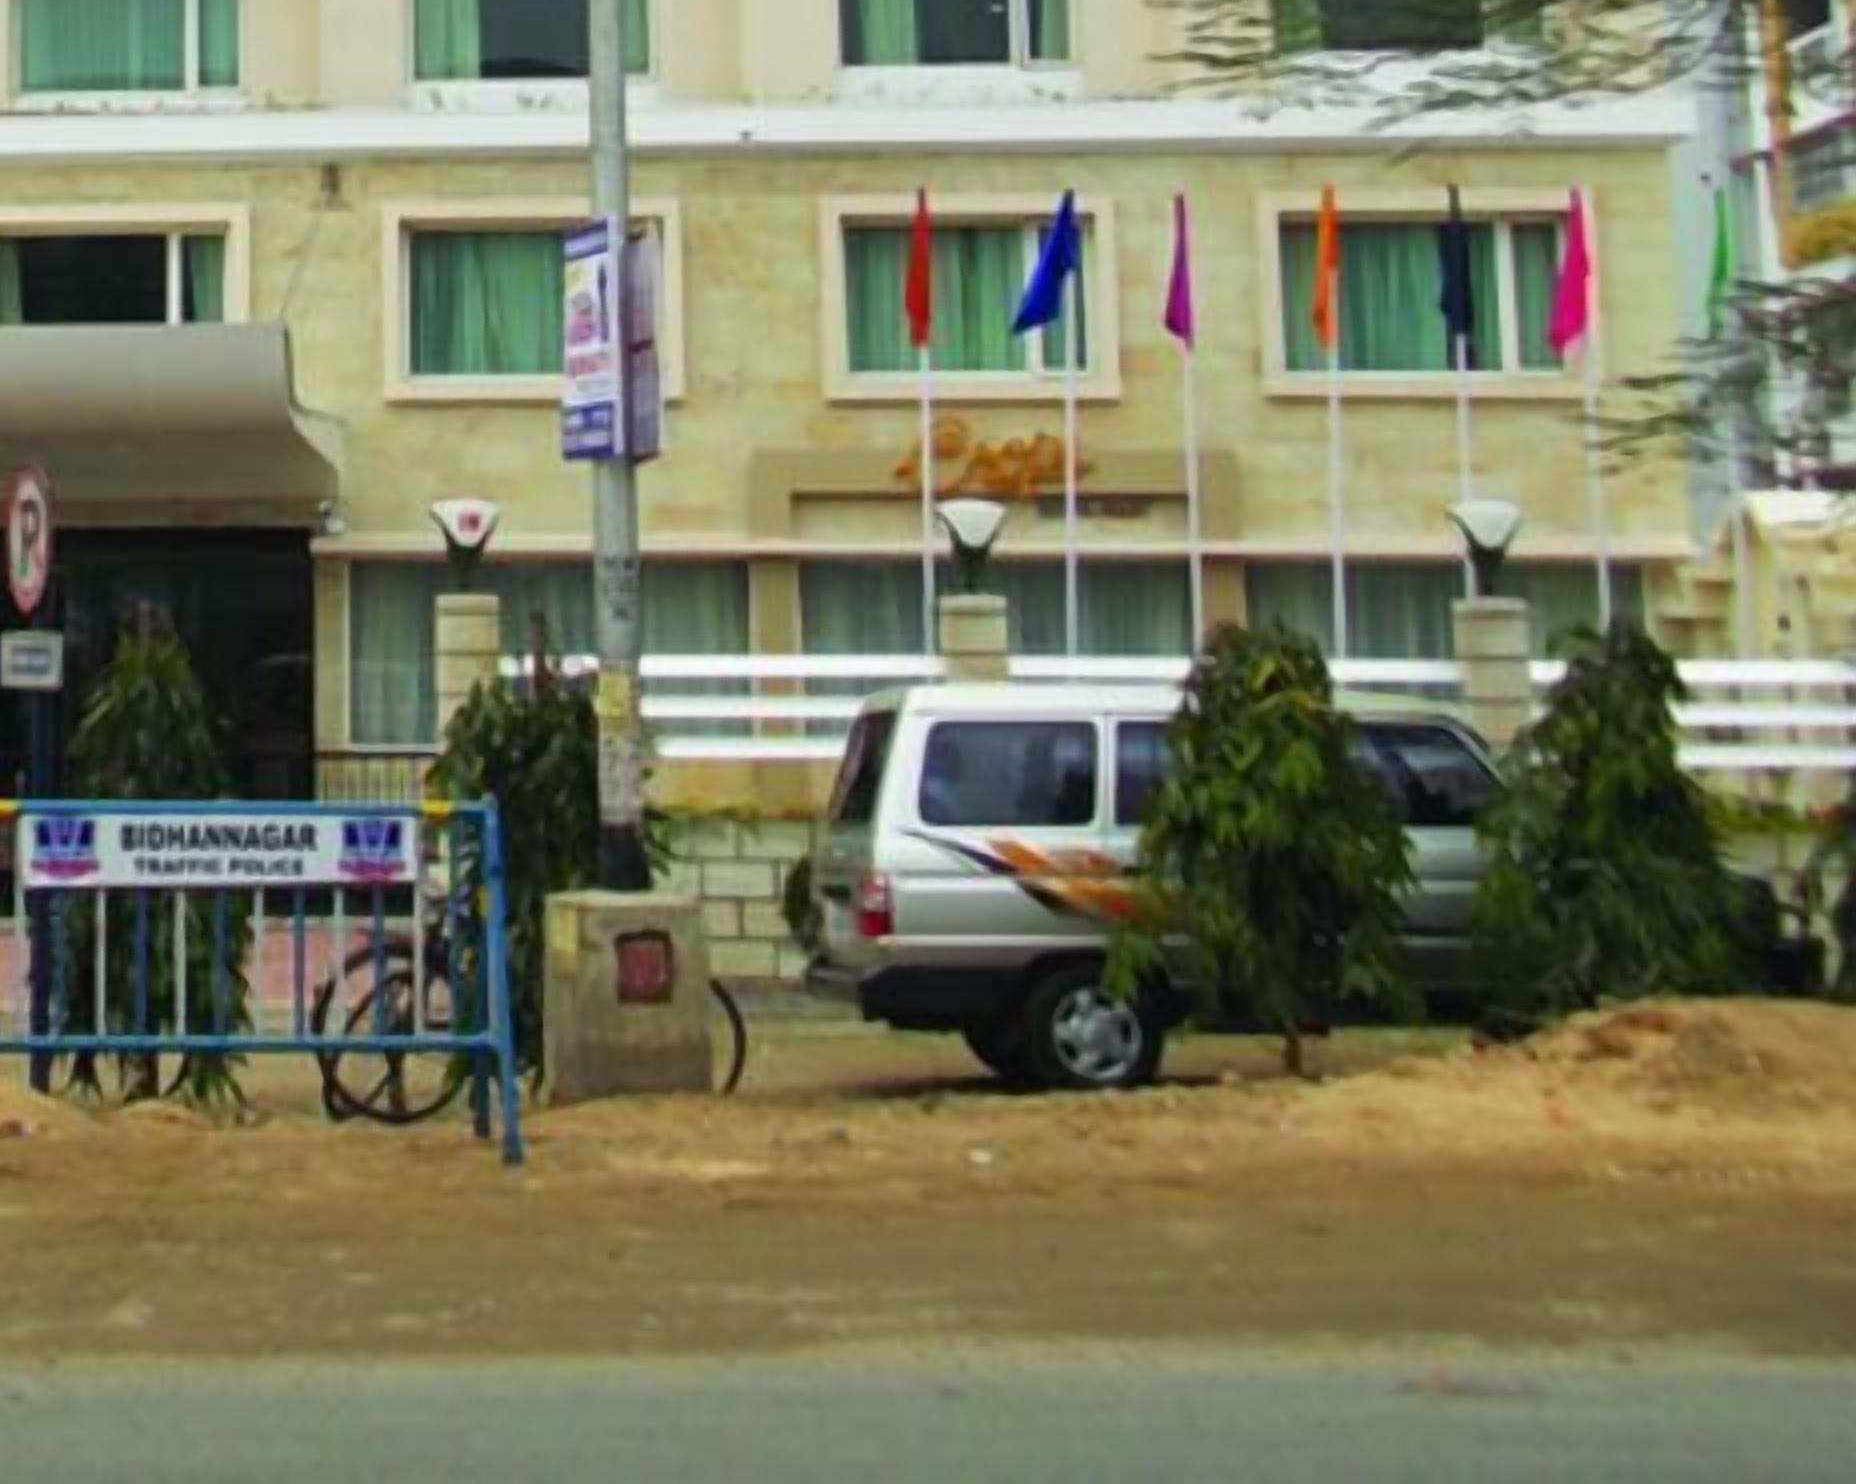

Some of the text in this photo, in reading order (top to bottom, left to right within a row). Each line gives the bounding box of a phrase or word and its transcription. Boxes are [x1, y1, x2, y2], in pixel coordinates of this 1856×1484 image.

[119, 822, 319, 852] BIDHANNAGAR
[133, 856, 305, 876] TRAFFIC POLICE
